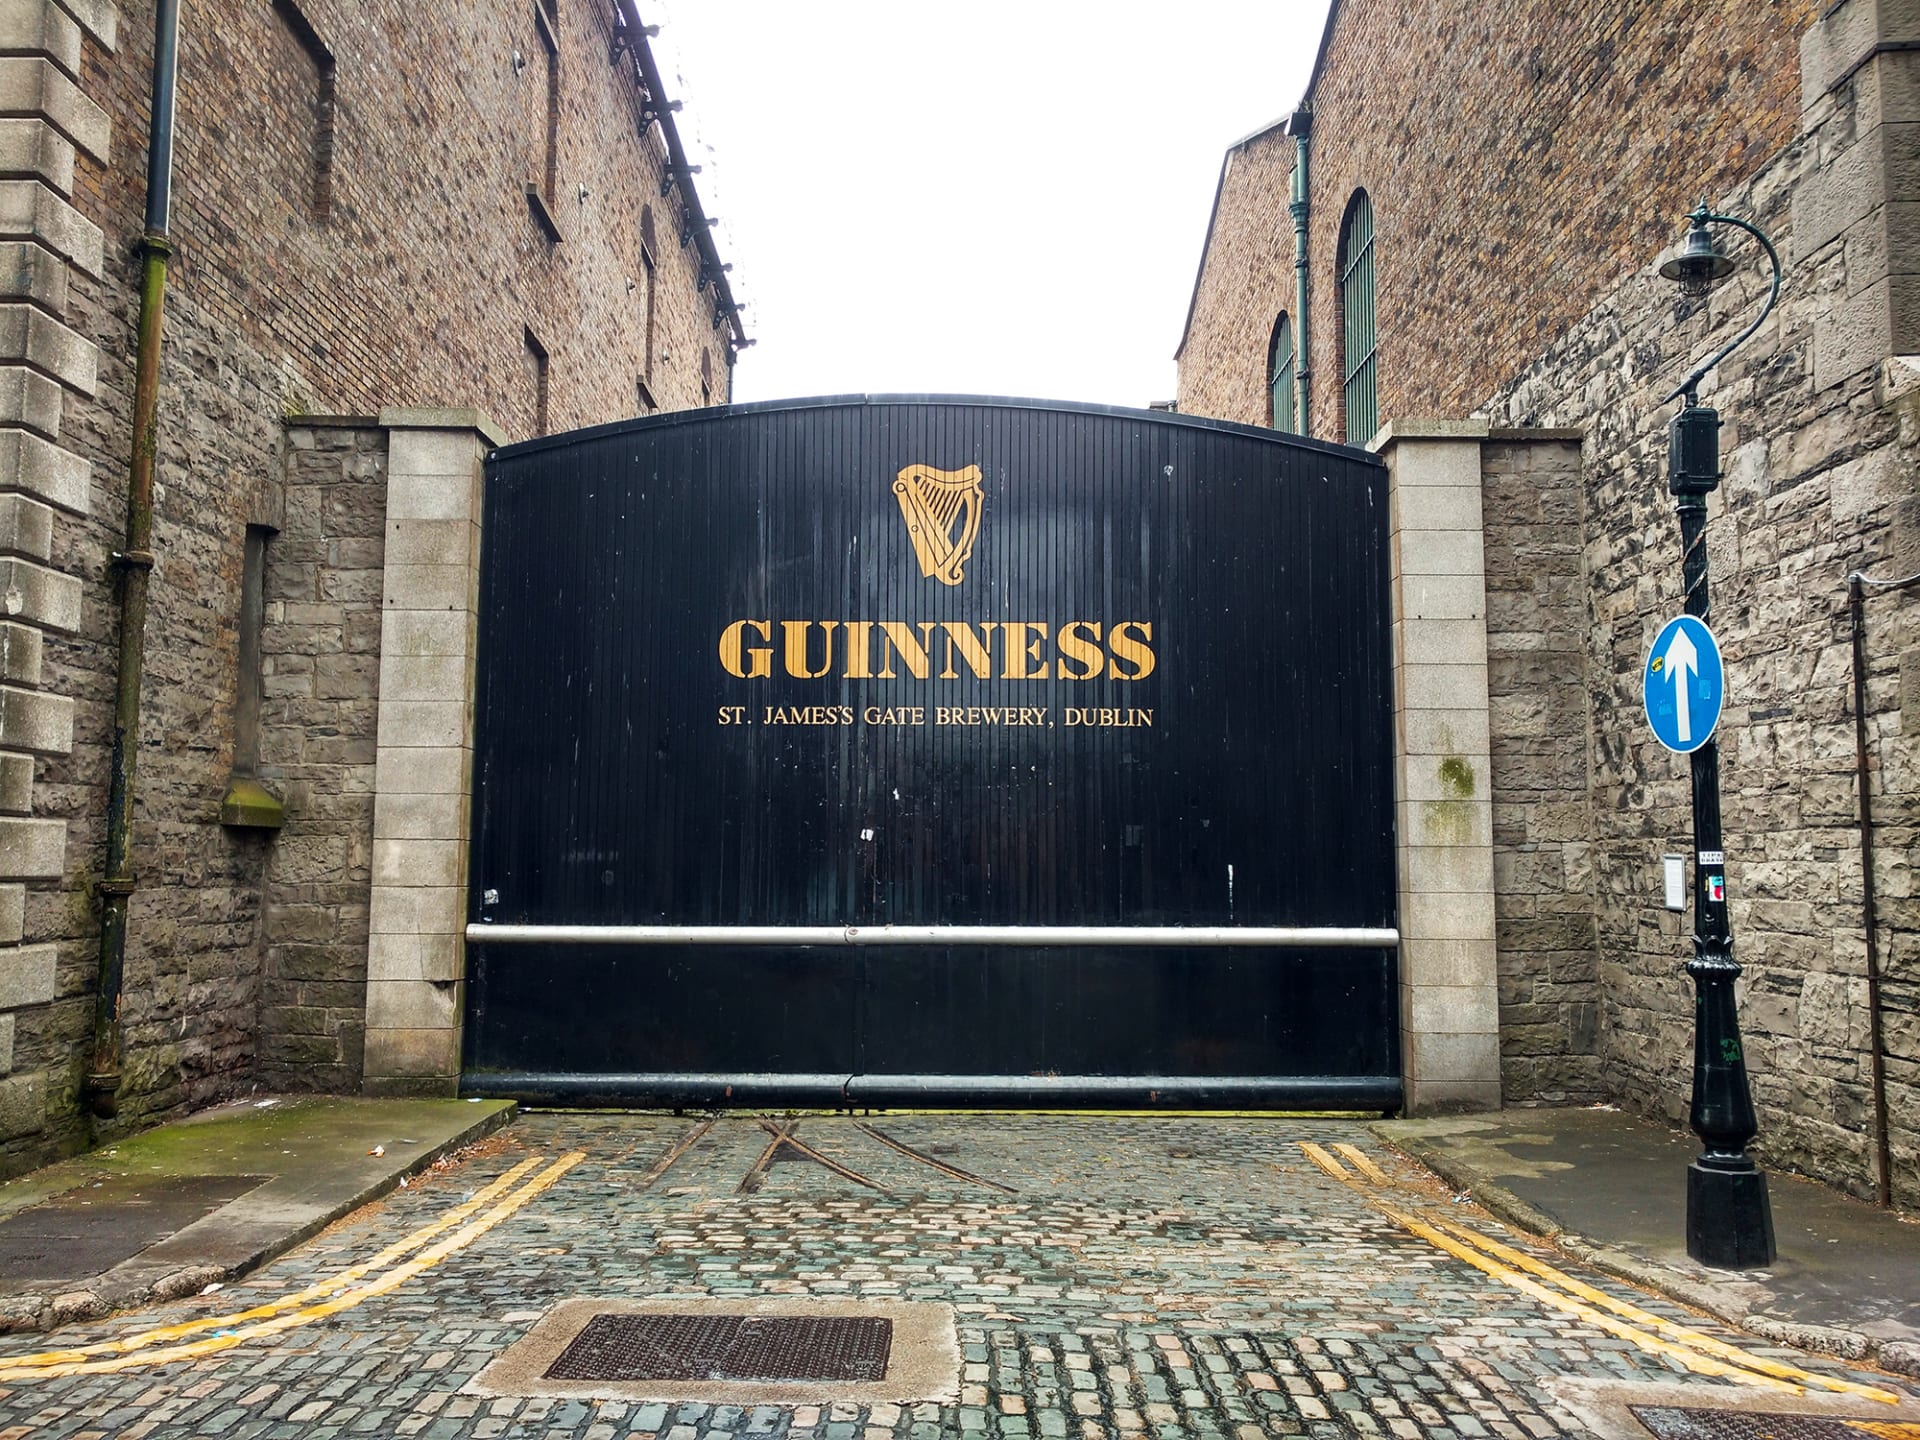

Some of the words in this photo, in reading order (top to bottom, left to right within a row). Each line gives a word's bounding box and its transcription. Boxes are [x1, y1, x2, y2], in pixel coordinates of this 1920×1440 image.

[718, 619, 1156, 681] GUINNESS
[718, 706, 752, 725] ST.
[763, 705, 854, 726] JAMES'S
[864, 706, 925, 726] GATE
[936, 706, 1054, 729] BREWERY,
[1065, 707, 1153, 727] DUBLIN
